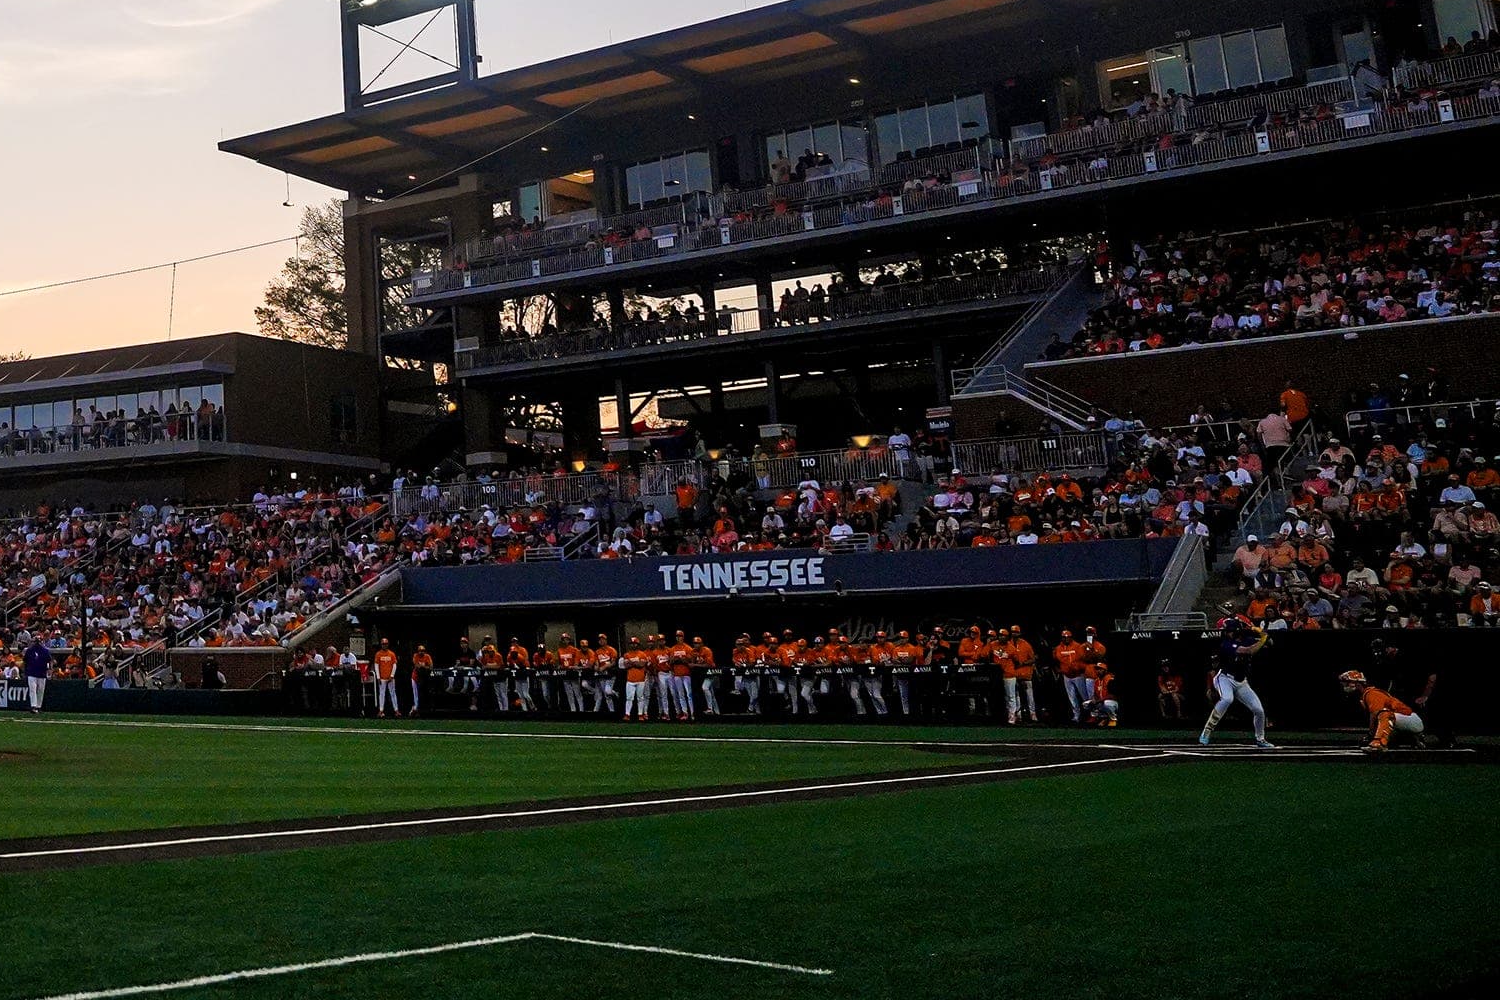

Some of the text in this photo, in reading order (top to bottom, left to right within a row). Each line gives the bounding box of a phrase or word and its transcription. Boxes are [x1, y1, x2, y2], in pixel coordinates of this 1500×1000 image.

[1042, 439, 1057, 449] 111
[800, 457, 816, 467] 110
[482, 485, 496, 494] 109
[658, 557, 825, 591] TENNESSEE
[8, 686, 30, 702] CITY
